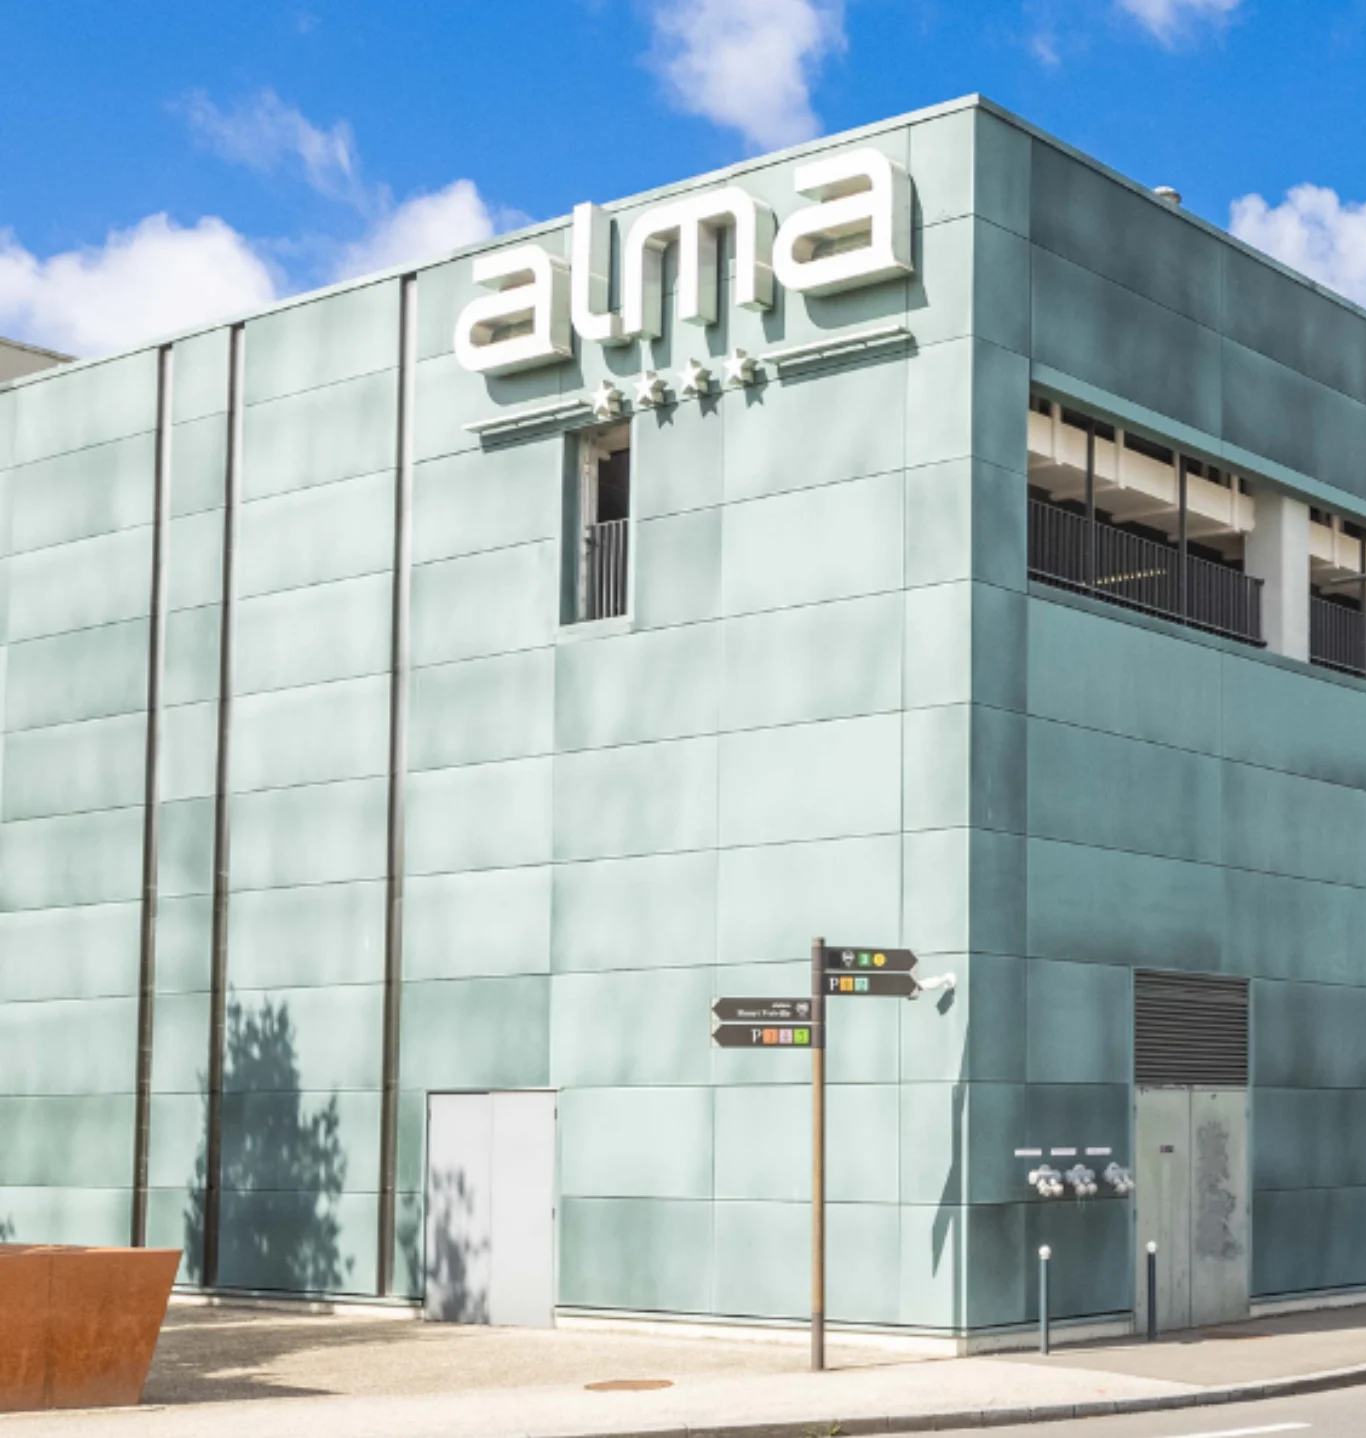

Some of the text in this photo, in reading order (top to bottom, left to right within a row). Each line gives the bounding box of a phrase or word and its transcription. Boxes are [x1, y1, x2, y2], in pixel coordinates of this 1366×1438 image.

[453, 147, 914, 377] alma
[829, 977, 839, 991] P
[751, 1028, 761, 1043] P
